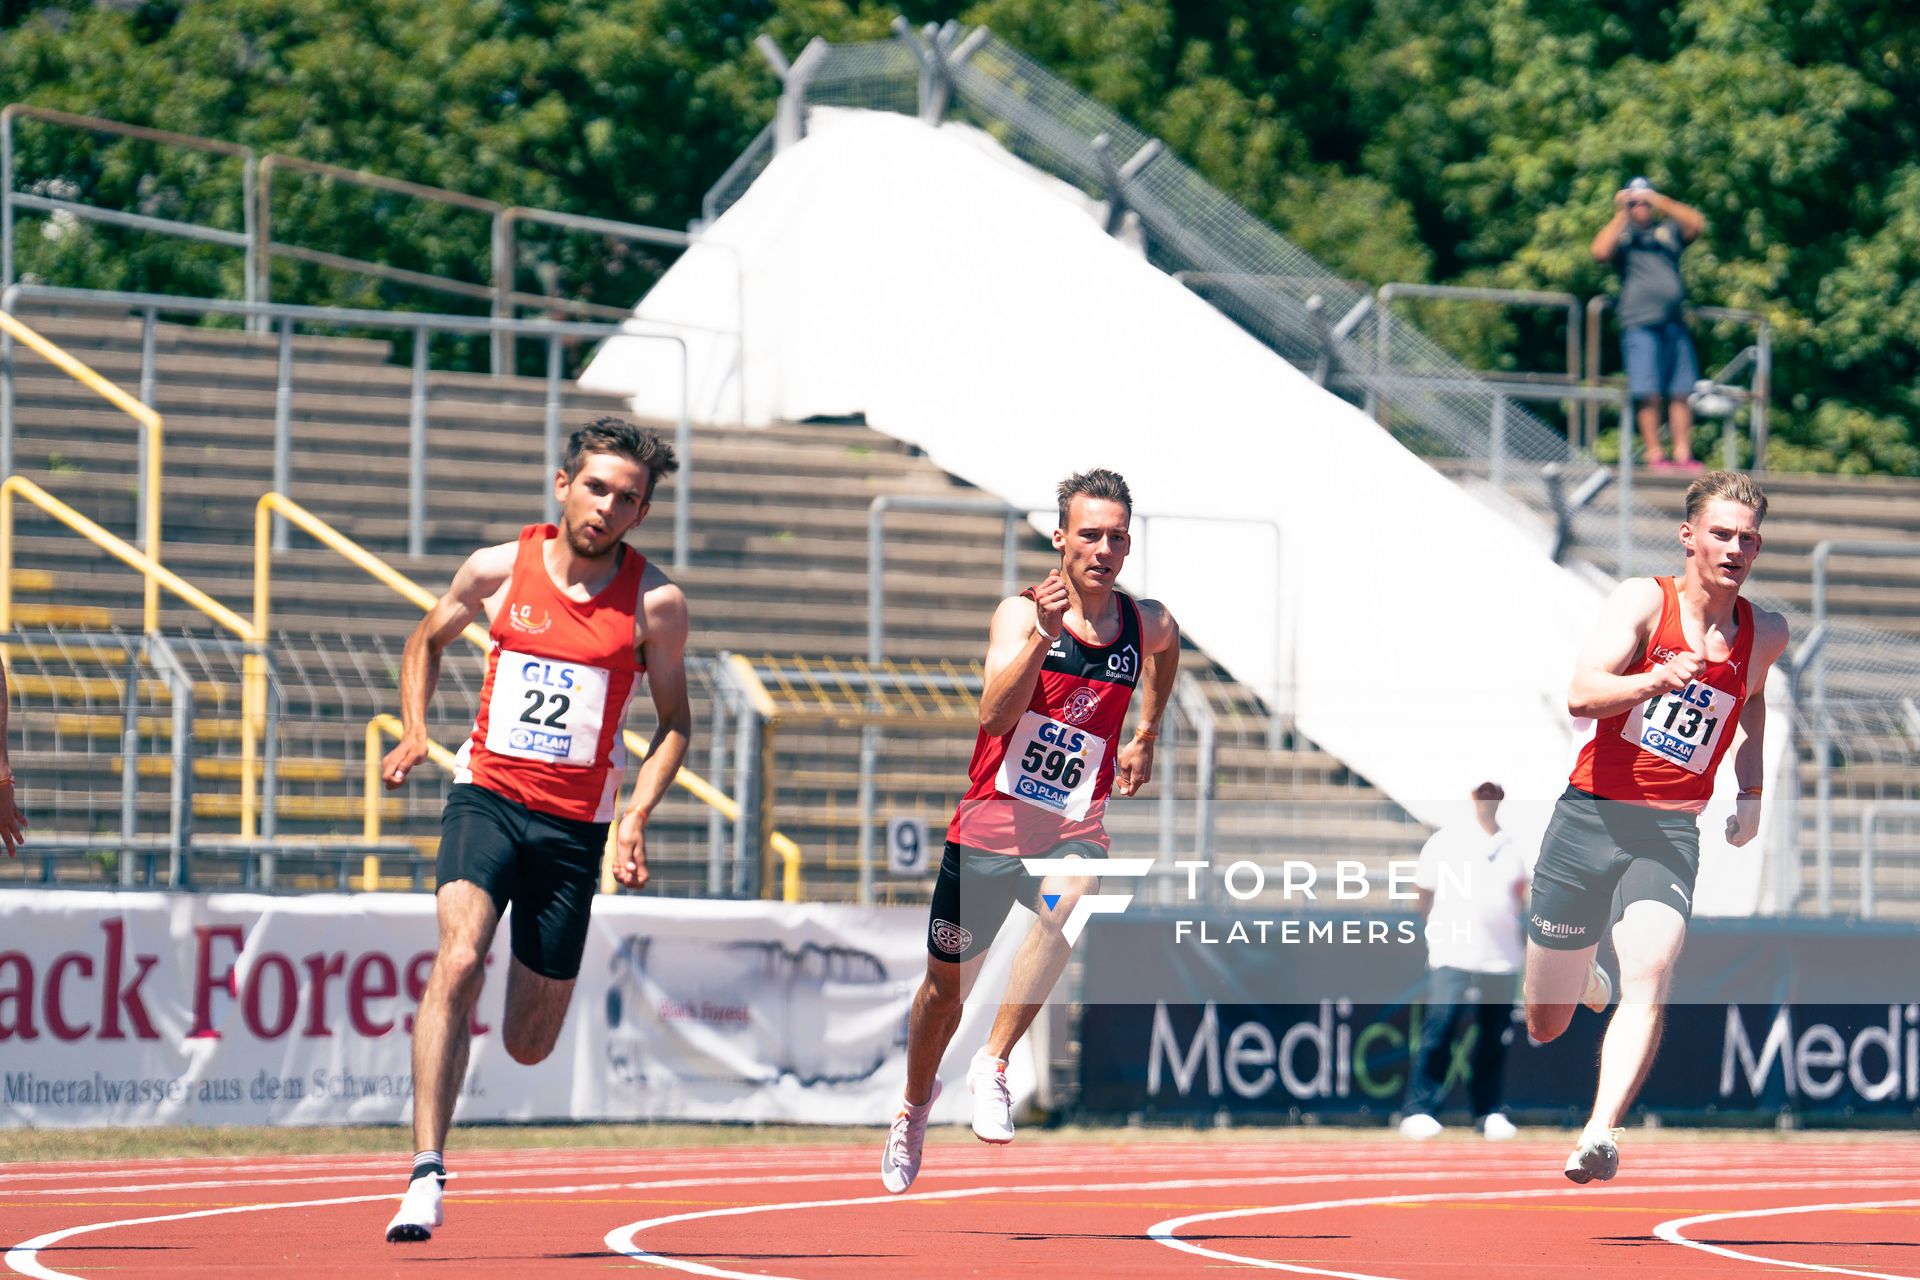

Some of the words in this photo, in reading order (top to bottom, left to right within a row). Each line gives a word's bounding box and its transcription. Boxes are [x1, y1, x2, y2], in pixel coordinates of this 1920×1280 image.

[1108, 654, 1129, 672] OS
[519, 689, 570, 730] 22
[534, 733, 570, 750] PLAN
[1664, 737, 1692, 756] PLAN
[1021, 740, 1085, 789] 596
[1037, 785, 1068, 805] PLAN
[896, 822, 919, 867] 9
[198, 1077, 242, 1103] aus
[250, 1068, 304, 1101] dem
